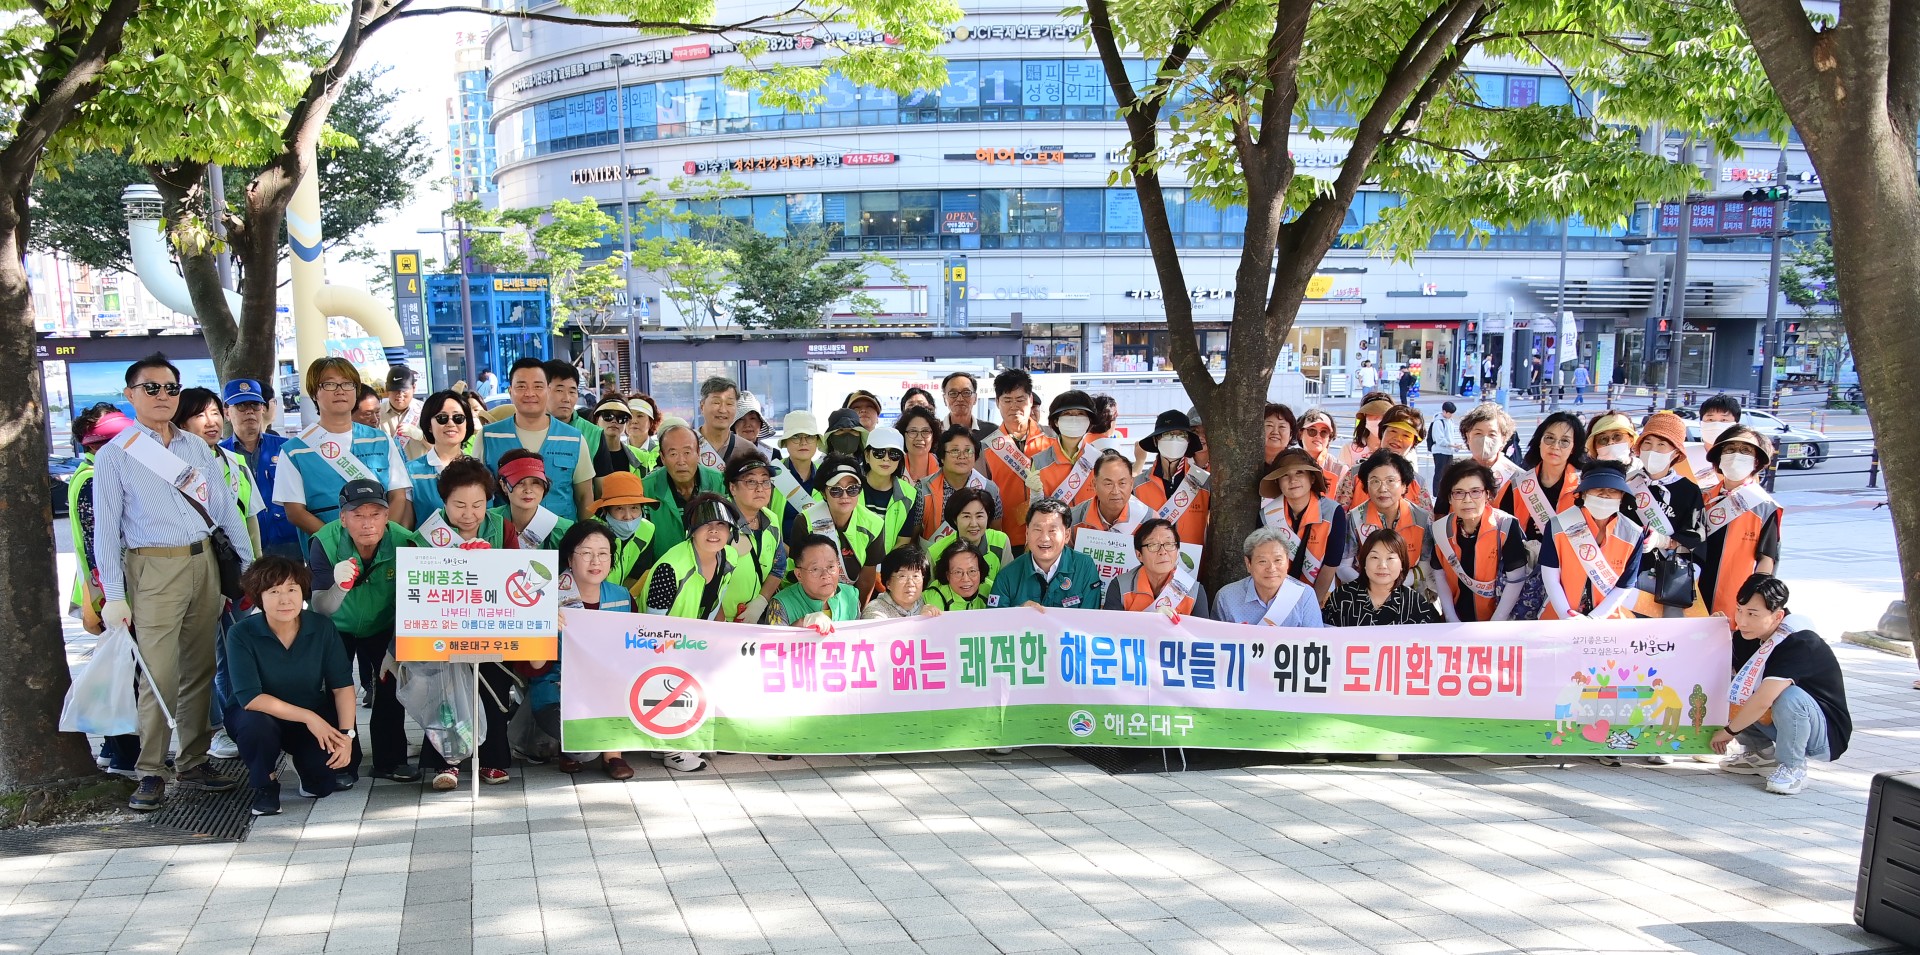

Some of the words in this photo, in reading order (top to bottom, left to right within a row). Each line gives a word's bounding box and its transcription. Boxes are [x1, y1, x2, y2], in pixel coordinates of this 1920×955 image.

[628, 49, 665, 66] 이노의원
[1046, 63, 1102, 82] 피부과
[1026, 83, 1101, 102] 성형외과
[846, 154, 890, 164] 741-7542
[975, 147, 1015, 165] 헤어
[572, 164, 632, 185] LUMIERE
[946, 212, 974, 221] OPEN
[1663, 204, 1680, 216] 안경렌
[1692, 204, 1715, 217] 안경테
[1662, 216, 1679, 228] 최저가
[1692, 217, 1714, 228] 최저가격
[407, 279, 417, 293] 4
[958, 286, 966, 300] 7
[994, 285, 1048, 300] OLENS
[1422, 282, 1438, 296] kt
[409, 303, 420, 336] 해운대
[56, 346, 76, 355] BRT
[852, 345, 870, 353] BRT
[902, 381, 929, 390] Busan
[930, 381, 939, 390] is
[407, 570, 479, 586] 담배꽁초는
[407, 588, 421, 604] 꼭
[426, 588, 498, 604] 쓰레기통에
[441, 608, 471, 618] 나부터!
[477, 608, 516, 618] 지금부터!
[403, 619, 438, 630] 담배꽁초
[441, 619, 459, 630] 없는
[461, 619, 496, 630] 아름다운
[498, 619, 524, 630] 해운대
[526, 620, 551, 630] 만들기
[637, 628, 683, 639] Sun&Fun
[449, 640, 490, 651] 해운대구
[493, 640, 520, 651] 우1동
[624, 630, 708, 654] Haeundae
[1629, 639, 1676, 656] 해운대
[889, 638, 948, 692] 없는
[959, 630, 1048, 688] 쾌적한
[1058, 630, 1148, 687] 해운대
[1272, 640, 1332, 694] 위한
[1342, 642, 1524, 697] 도시환경정비
[1103, 712, 1195, 737] 해운대구
